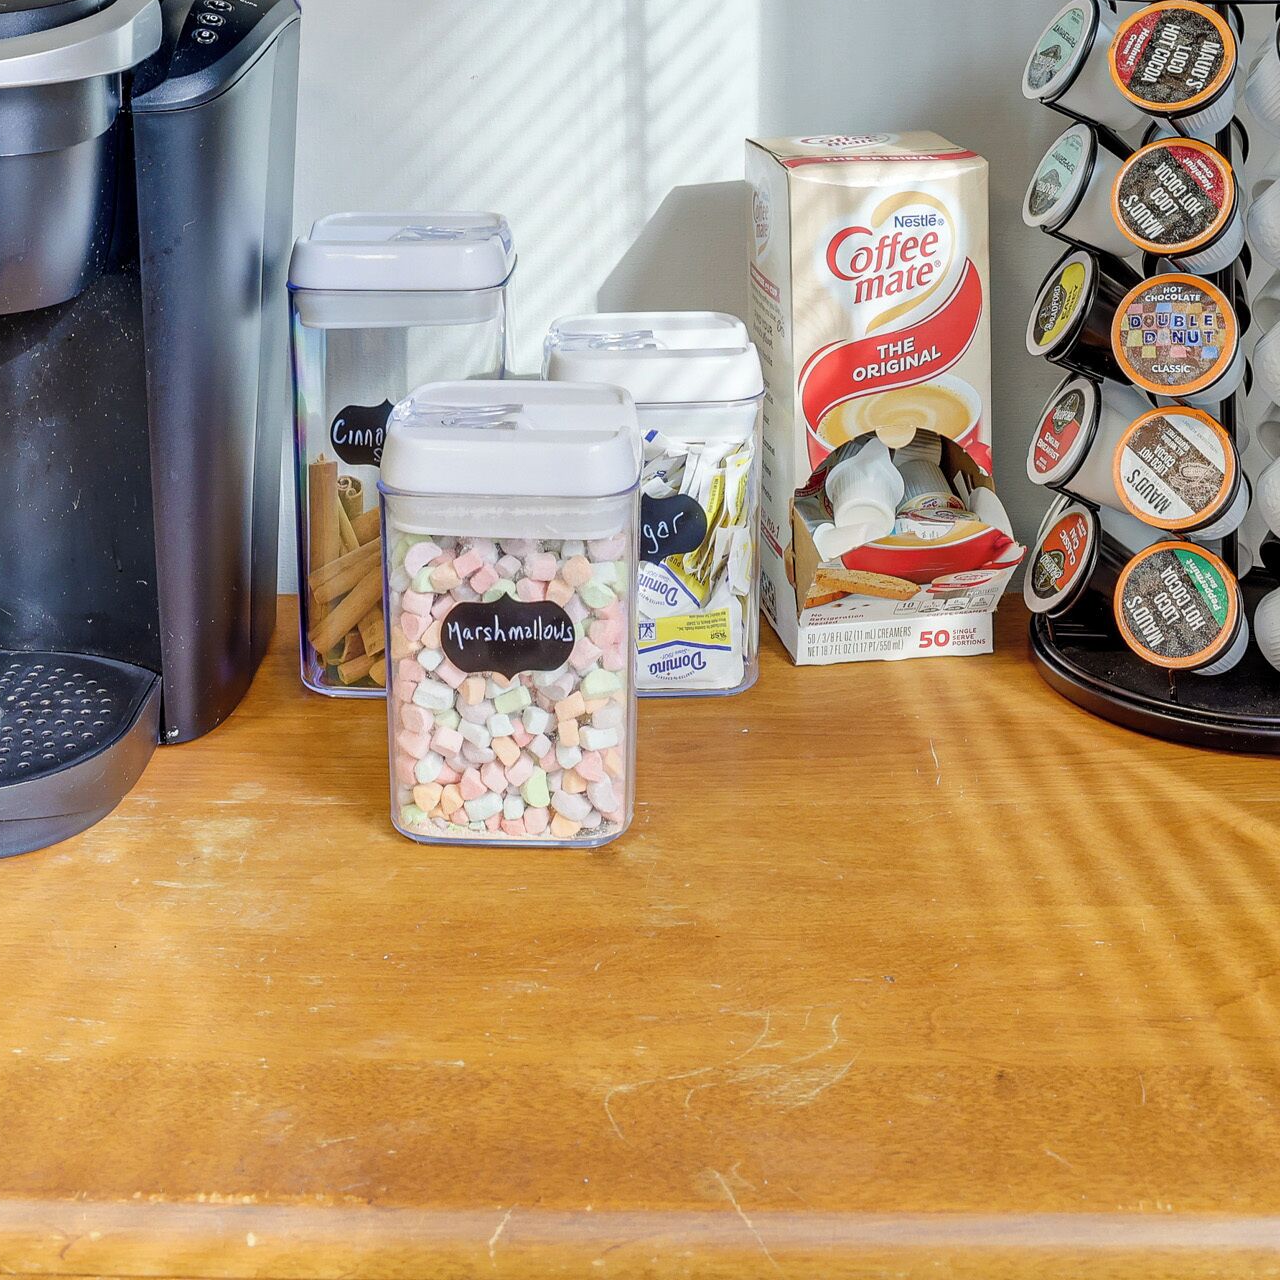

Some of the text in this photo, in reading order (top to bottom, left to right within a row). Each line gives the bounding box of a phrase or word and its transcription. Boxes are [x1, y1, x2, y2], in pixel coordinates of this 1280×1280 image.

[1141, 23, 1181, 83] HOT COCOA
[1167, 45, 1192, 74] LOCO
[1186, 40, 1221, 91] MAUD'S
[1150, 186, 1179, 216] LOCO
[1154, 161, 1205, 217] HOT COCOA
[1120, 194, 1165, 239] MAUD'S
[825, 225, 940, 282] Coffee
[854, 263, 936, 304] mate
[1145, 293, 1201, 302] CHOCOLATE
[1163, 286, 1183, 294] HOT
[852, 344, 942, 382] ORIGINAL
[876, 337, 915, 358] THE
[1151, 364, 1191, 373] CLASSIC
[1154, 443, 1176, 468] COCOA
[1126, 469, 1172, 514] MAUD'S
[639, 574, 678, 607] Domin
[1160, 565, 1206, 631] HOT COCOA
[1186, 558, 1222, 611] Peppermint
[1125, 596, 1165, 648] MAUD'S
[1153, 591, 1180, 625] LOCO
[447, 615, 574, 650] Marshmallows
[807, 634, 816, 645] 50
[835, 631, 842, 642] FL
[844, 631, 853, 641] OZ
[877, 626, 912, 638] CREAMERS
[918, 629, 950, 648] 50
[952, 627, 977, 635] SINGLE
[952, 638, 986, 646] PORTIONS
[649, 651, 707, 675] Domino
[807, 645, 819, 657] NET
[834, 644, 841, 654] FL
[843, 643, 852, 654] OZ
